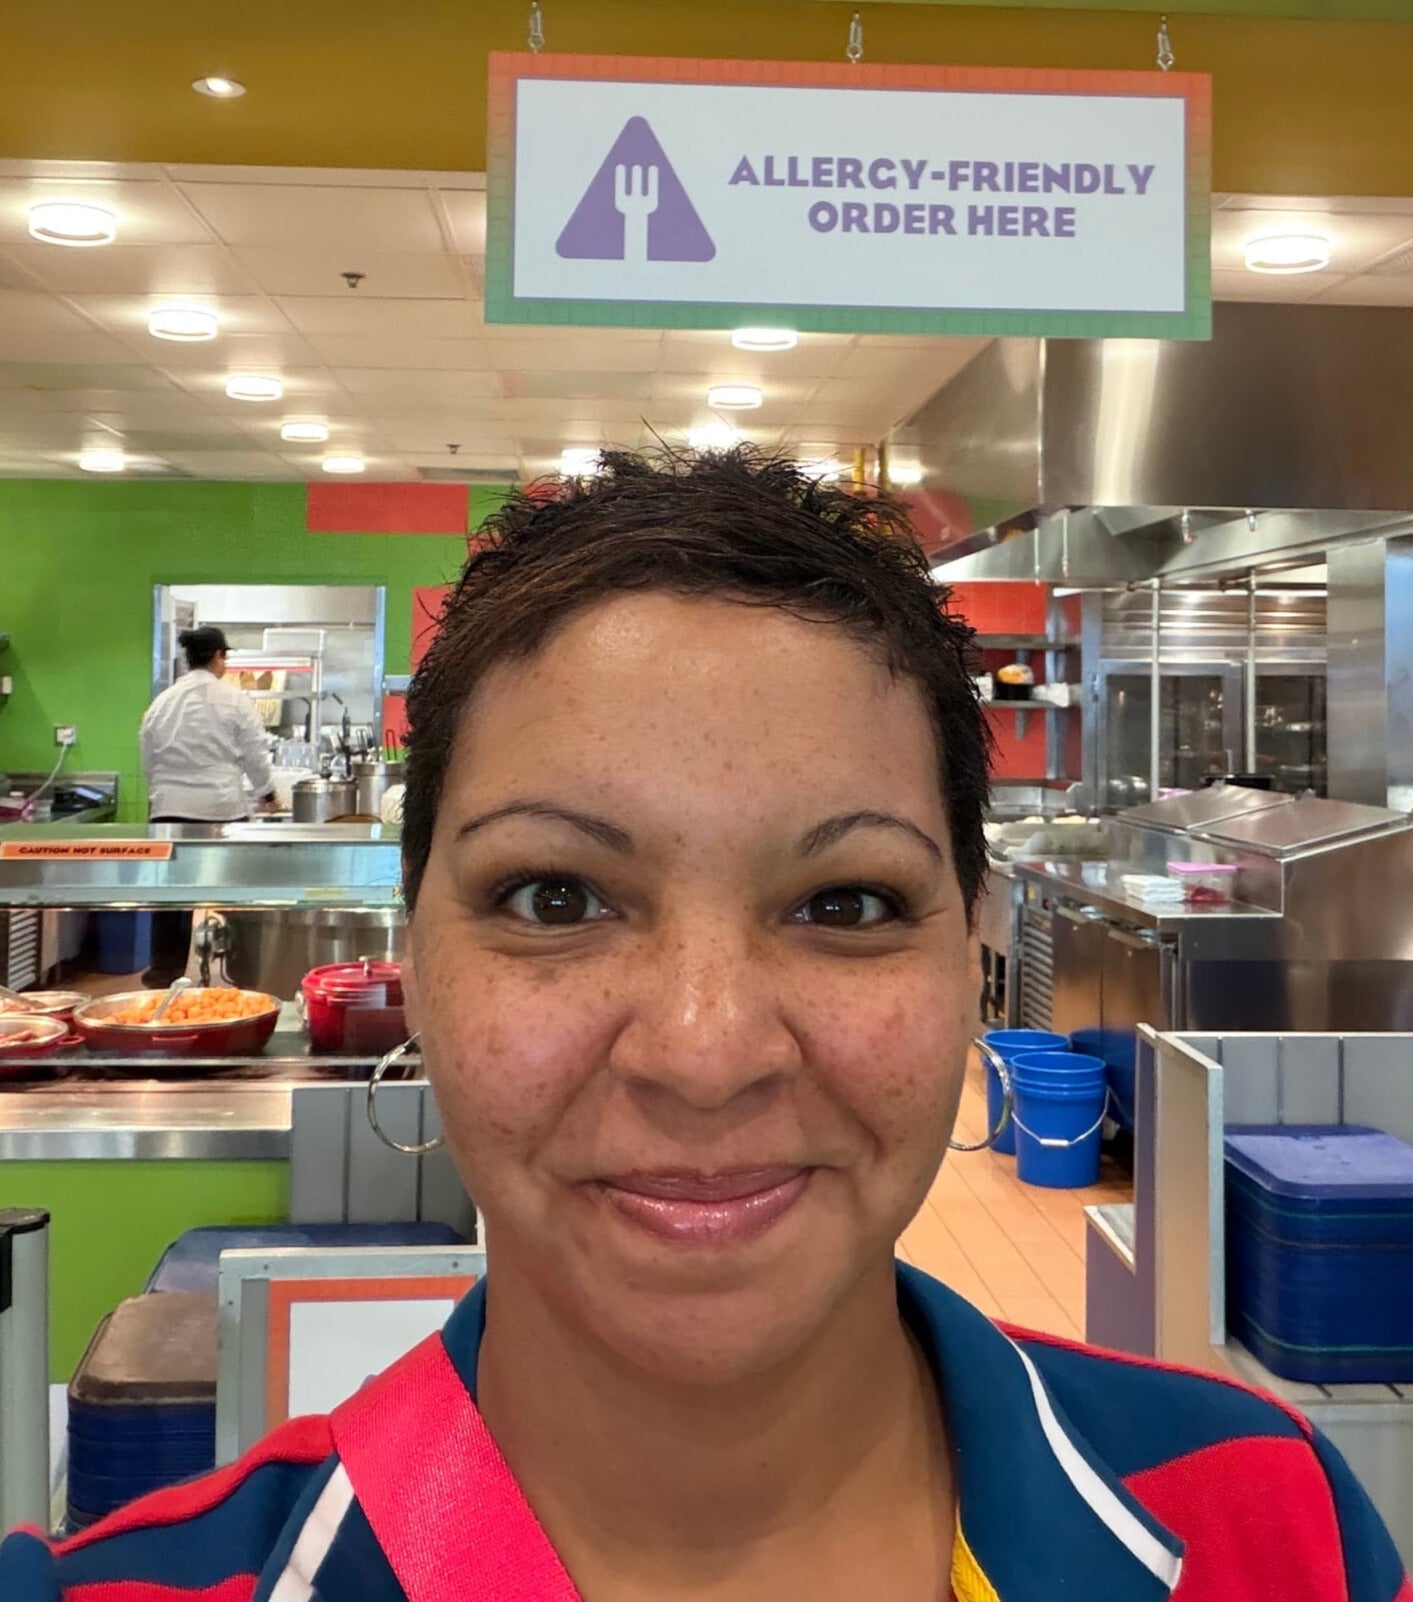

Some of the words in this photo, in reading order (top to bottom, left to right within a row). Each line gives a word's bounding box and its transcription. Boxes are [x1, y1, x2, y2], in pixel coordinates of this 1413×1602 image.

[728, 155, 1156, 195] ALLERGY-FRIENDLY
[808, 201, 958, 236] ORDER
[967, 205, 1076, 238] HERE
[19, 846, 70, 856] CAUTION
[100, 846, 151, 856] SURFACE
